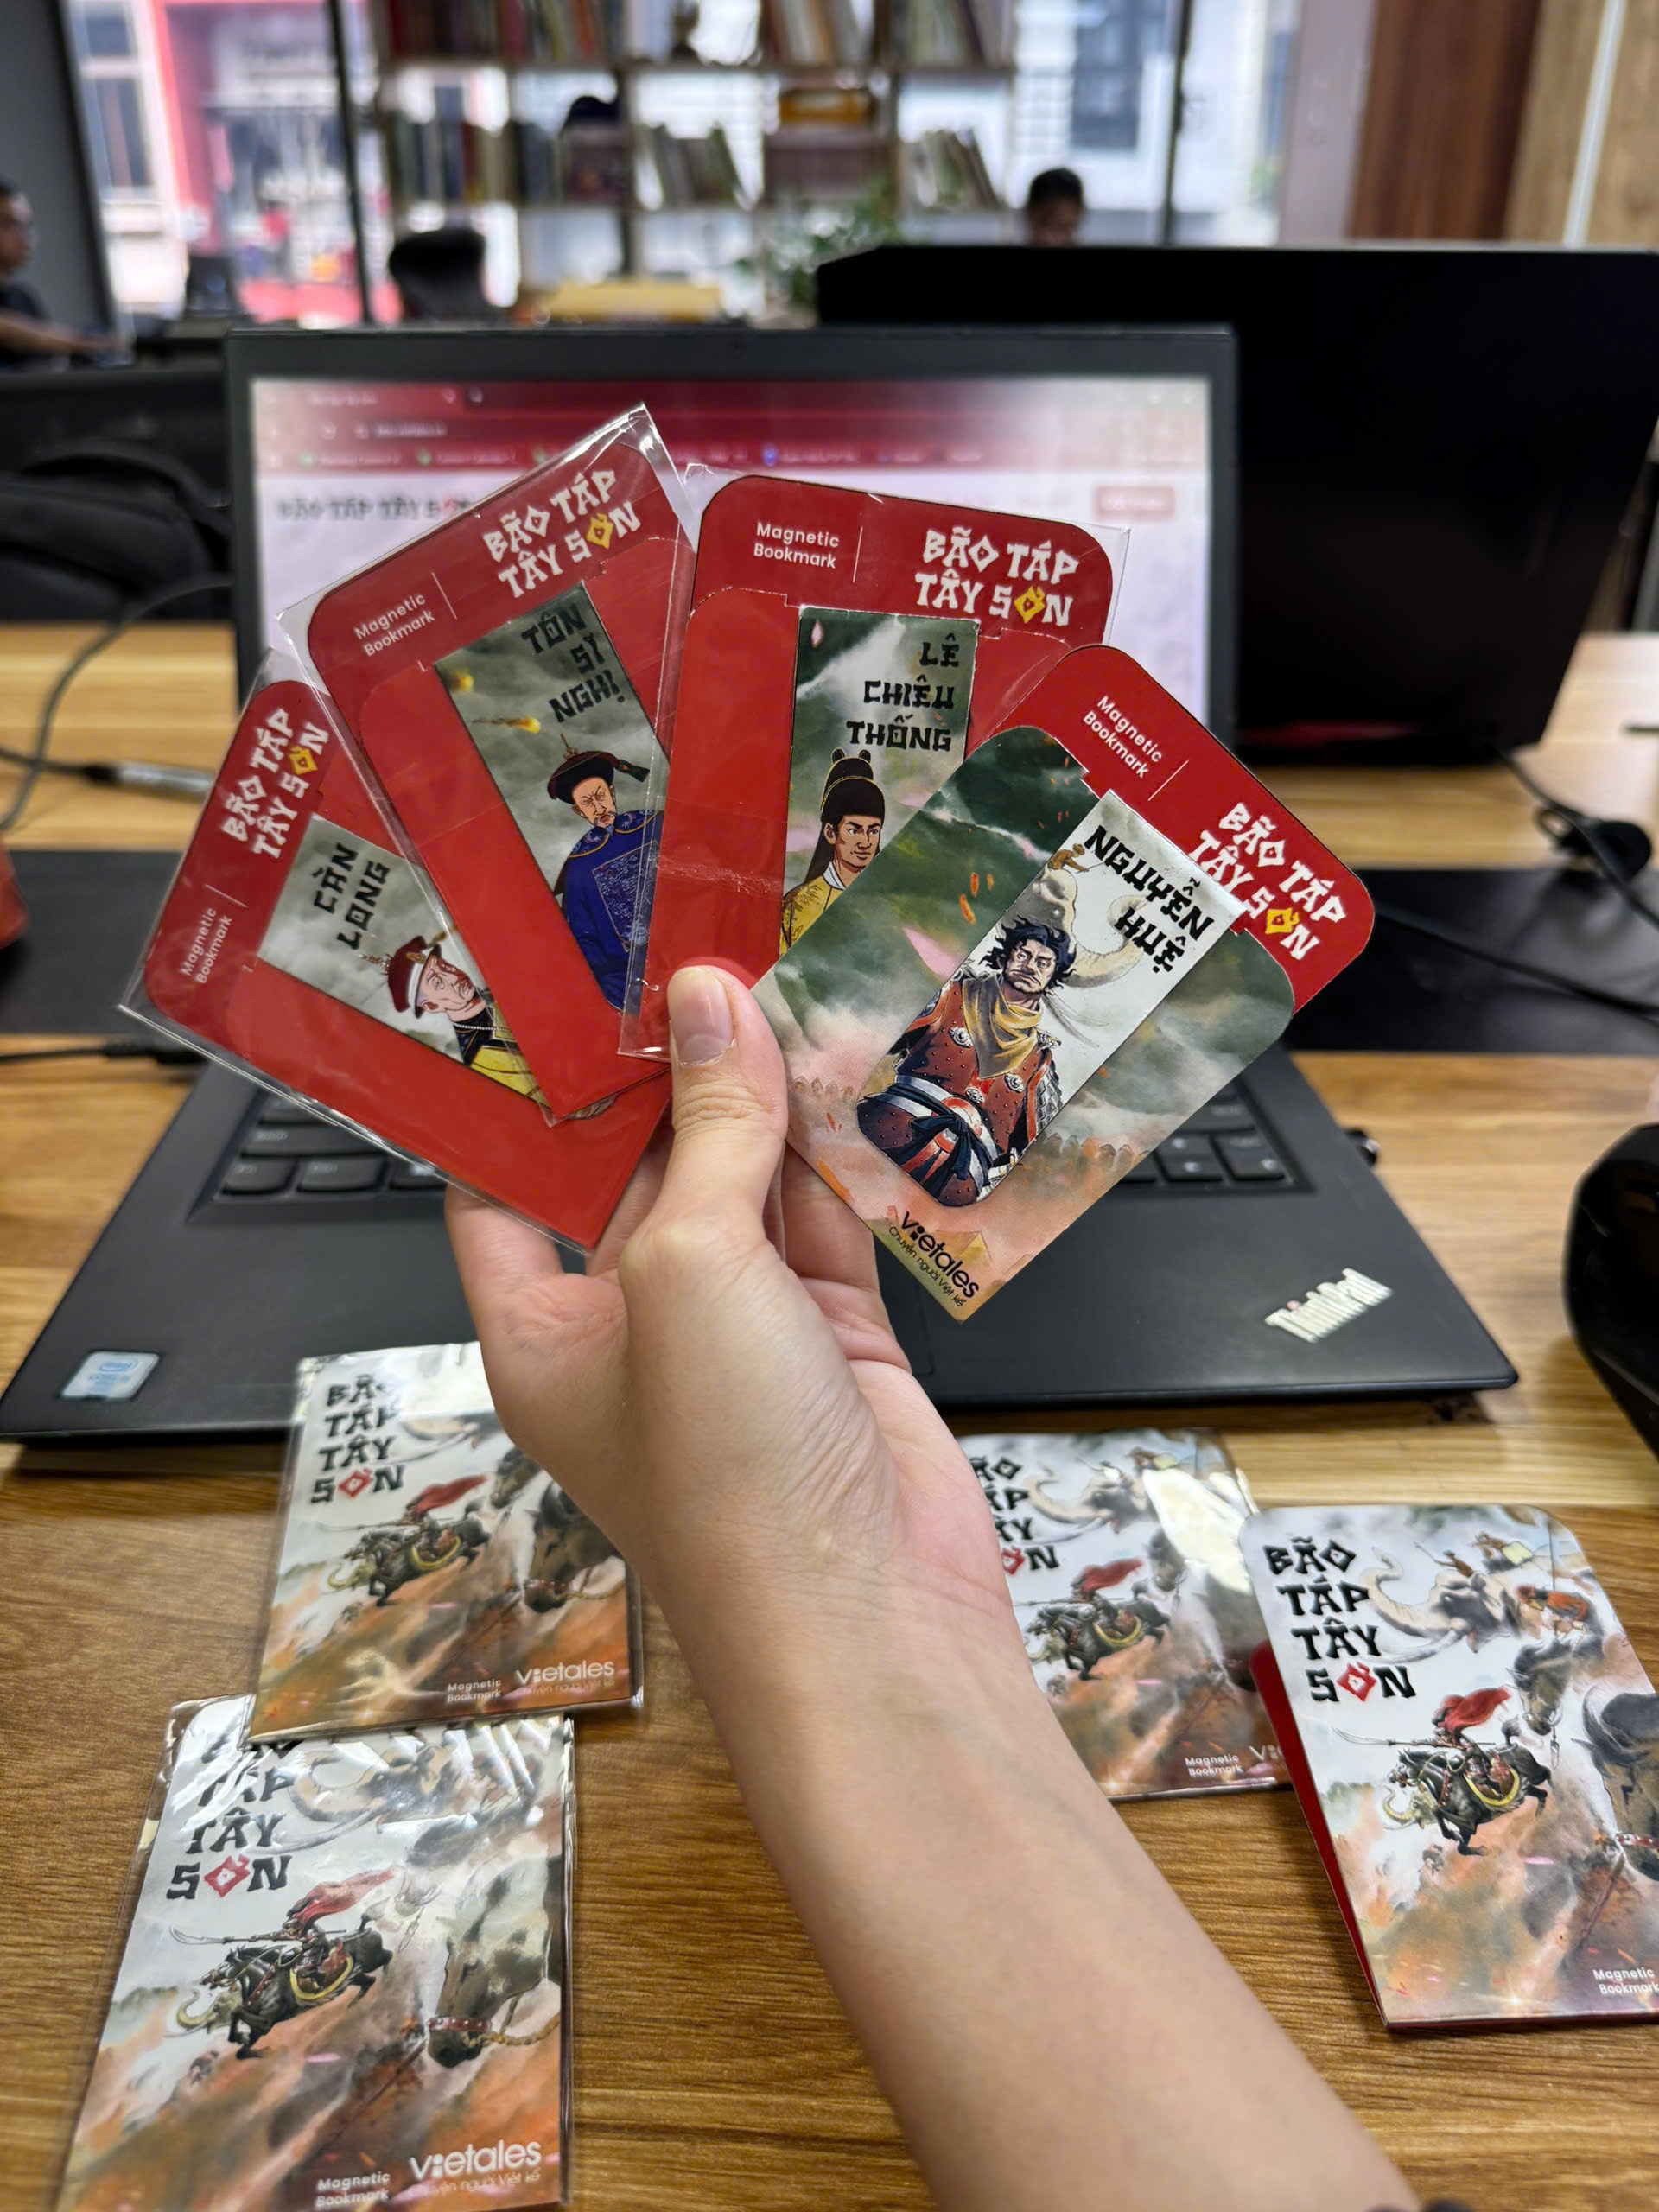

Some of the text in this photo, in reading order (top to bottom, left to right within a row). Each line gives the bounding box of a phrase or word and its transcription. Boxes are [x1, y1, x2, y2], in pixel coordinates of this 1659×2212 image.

[483, 470, 616, 563] BÃO TÁP
[756, 522, 839, 549] Magnetic
[498, 500, 641, 598] TÂY SƠN
[753, 543, 836, 569] Bookmark
[921, 525, 1079, 584] BÃO TÁP
[353, 594, 426, 640] Magnetic
[915, 569, 1073, 626] TÂY SƠN
[364, 609, 435, 657] Bookmark
[520, 603, 587, 655] TÔN
[919, 632, 960, 667] LÊ
[548, 670, 626, 722] NGHỊ
[863, 674, 955, 709] CHIÊU
[846, 714, 952, 752] THỐNG
[1083, 710, 1148, 779] Bookmark
[1096, 695, 1163, 763] Magnetic
[221, 708, 293, 842] BÃO TÁP
[252, 721, 328, 858] TÂY SƠN
[312, 843, 359, 914] CÀN
[1084, 824, 1214, 942] NGUYỄN
[1219, 803, 1346, 924] BÃO TÁP
[337, 861, 391, 950] LONG
[1188, 830, 1320, 961] TÂY SƠN
[180, 908, 217, 976] Magnetic
[195, 916, 232, 983] Bookmark
[1115, 906, 1185, 974] HUỆ
[327, 1373, 387, 1407] BÃ
[318, 1433, 396, 1471] TÂY
[969, 1455, 1023, 1482] ÃO
[310, 1465, 404, 1503] SƠN
[983, 1484, 1030, 1511] ÁP
[992, 1515, 1033, 1542] ÂY
[1001, 1545, 1060, 1575] ƠN
[1262, 1535, 1357, 1576] BÃO
[1275, 1573, 1371, 1616] TÁP
[1290, 1615, 1382, 1661] TÂY
[447, 1688, 502, 1702] Bookmark
[448, 1678, 502, 1693] Magnetic
[1306, 1661, 1417, 1703] SƠN
[1185, 1753, 1240, 1767] Magnetic
[1188, 1764, 1243, 1777] Bookmark
[166, 1853, 293, 1900] SƠN
[1592, 1967, 1656, 1982] Magnetic
[315, 2189, 390, 2210] Bookmark
[317, 2171, 391, 2193] Magnetic
